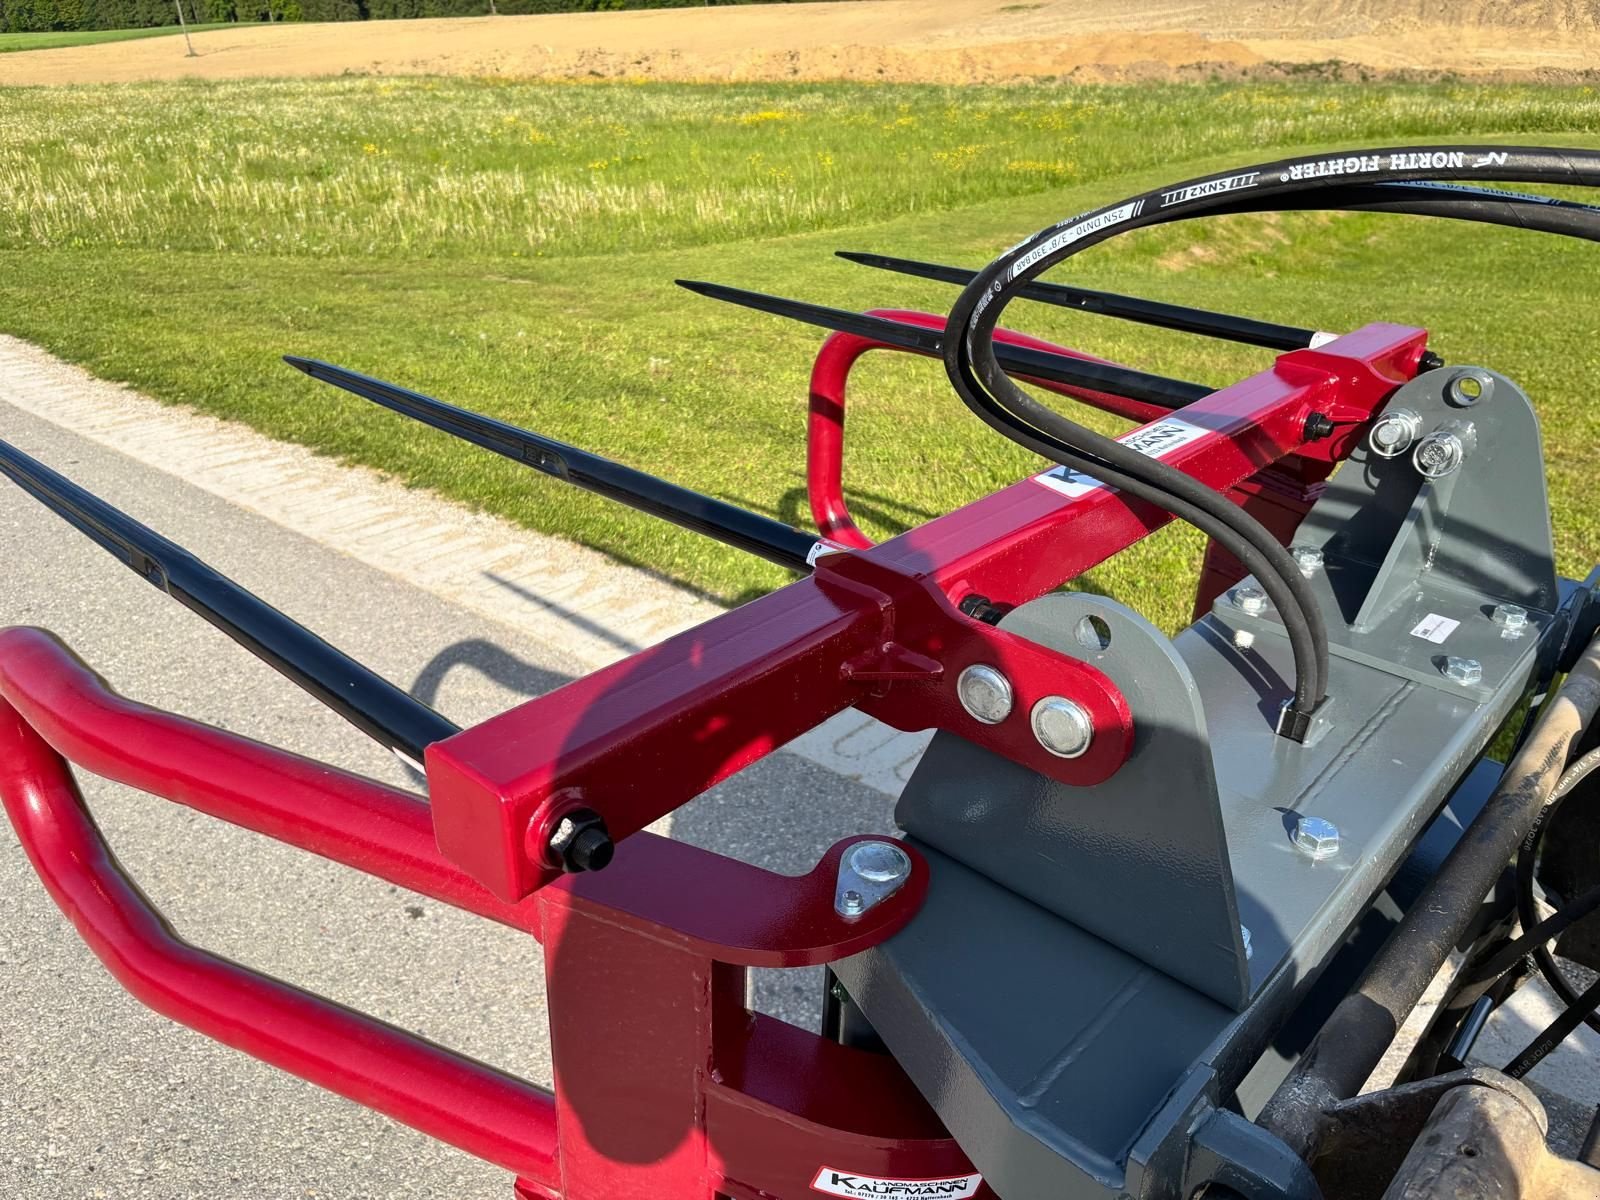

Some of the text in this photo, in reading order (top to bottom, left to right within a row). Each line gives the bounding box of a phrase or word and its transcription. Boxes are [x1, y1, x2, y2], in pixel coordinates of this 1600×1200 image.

[1389, 152, 1464, 171] NORTH
[1190, 180, 1228, 198] SNX2
[1103, 208, 1125, 225] 2SN
[1075, 216, 1102, 236] DN10
[1032, 245, 1048, 261] 330
[1016, 256, 1031, 272] BAR
[831, 1173, 967, 1195] KAUFMANN
[874, 1178, 969, 1188] LANDMASCHINEN
